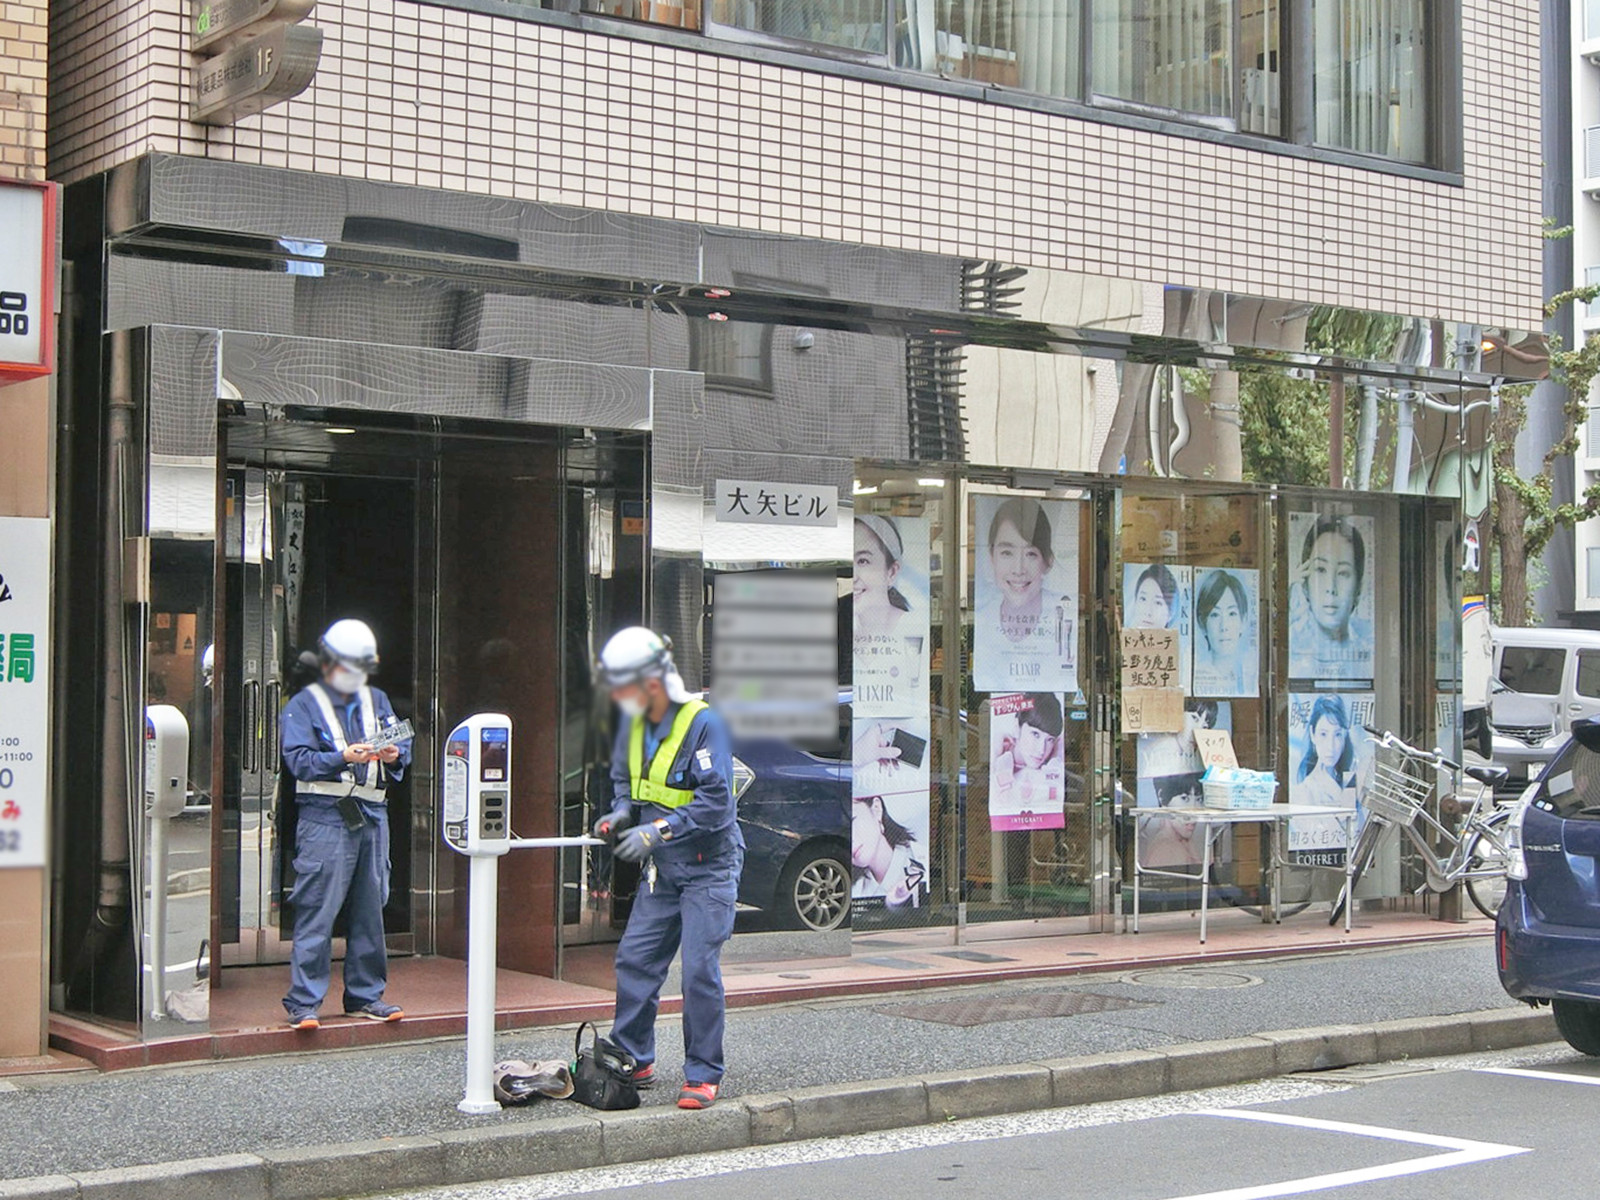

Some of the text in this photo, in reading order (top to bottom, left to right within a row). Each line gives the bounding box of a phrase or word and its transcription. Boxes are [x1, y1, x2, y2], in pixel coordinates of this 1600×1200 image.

[258, 47, 274, 76] 1F
[727, 487, 829, 518] 大矢ビル
[1180, 570, 1191, 637] HAKU
[0, 633, 35, 683] 局
[1009, 662, 1041, 676] ELIXIR
[1297, 853, 1338, 866] COFFRET
